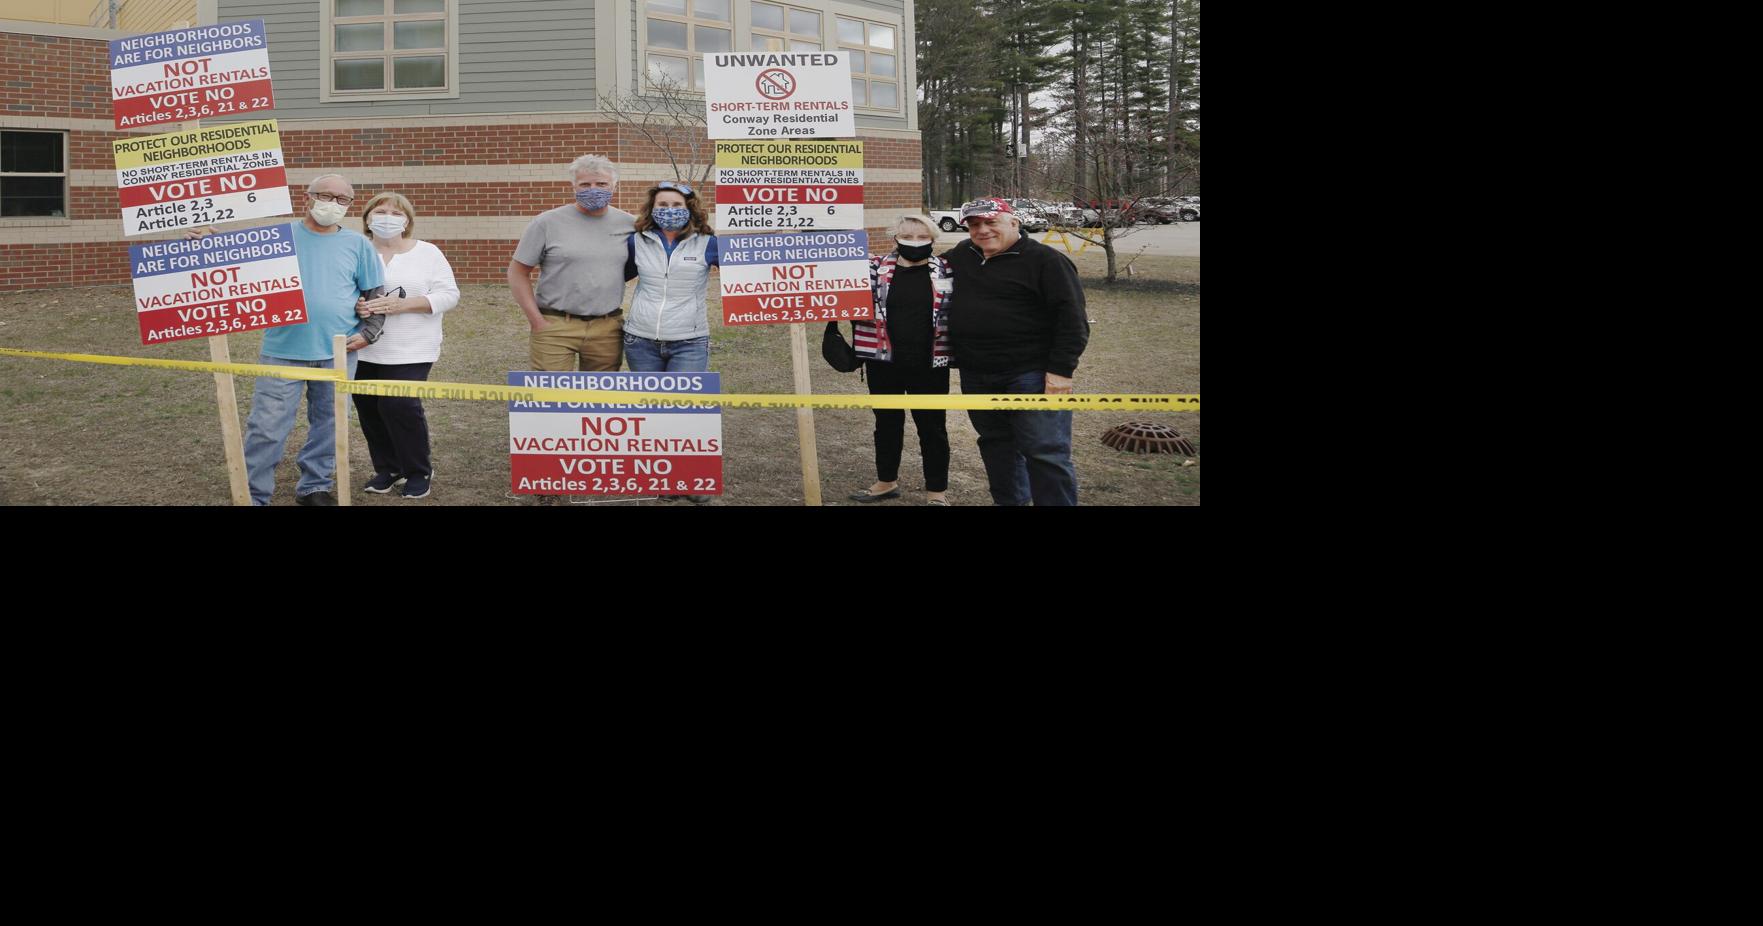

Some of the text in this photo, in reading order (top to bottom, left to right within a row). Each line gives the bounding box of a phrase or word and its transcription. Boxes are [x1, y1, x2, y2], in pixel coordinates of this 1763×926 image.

[121, 23, 251, 51] NEIGHBORHOODS
[114, 36, 261, 65] ARE FOR NEIGHBORS
[164, 58, 211, 78] NOT
[715, 54, 838, 67] UNWANTED
[114, 67, 268, 97] VACATION RENTALS
[150, 87, 234, 109] VOTE NO
[711, 101, 848, 112] SHORT-TERM RENTALS
[120, 110, 172, 126] Articles
[176, 105, 214, 120] 2,3,6,
[218, 101, 234, 112] 21
[252, 97, 269, 107] 22
[723, 114, 838, 125] Conway Residential
[115, 123, 276, 154] PROTECT OUR RESIDENTIAL
[748, 126, 815, 135] Zone Areas
[144, 139, 251, 162] NEIGHBORHOODS
[717, 144, 862, 154] PROTECT OUR RESIDENTIAL
[122, 169, 138, 178] NO
[140, 160, 209, 176] SHORT-TERM
[211, 153, 259, 165] RENTALS
[742, 156, 838, 165] NEIGHBORHOODS
[123, 158, 279, 185] CONWAY RESIDENTIAL ZONES
[149, 173, 256, 201] VOTE NO
[742, 188, 838, 202] VOTE NO
[136, 192, 256, 218] Article 2,3 6
[728, 206, 835, 217] Article 2,3 6
[138, 208, 234, 231] Article 21,22
[728, 218, 814, 228] Article 21,22
[142, 228, 280, 258] NEIGHBORHOODS
[730, 234, 855, 248] NEIGHBORHOODS
[136, 241, 291, 274] ARE FOR NEIGHBORS
[723, 246, 864, 262] ARE FOR NEIGHBORS
[191, 267, 241, 288] NOT
[772, 265, 817, 280] NOT
[139, 276, 300, 309] VACATION RENTALS
[724, 278, 869, 294] VACATION RENTALS
[177, 299, 266, 322] VOTE NO
[758, 295, 838, 309] VOTE NO
[728, 311, 778, 323] Articles
[781, 310, 818, 322] 2,3,6,
[822, 308, 837, 318] 21
[853, 307, 869, 317] 22
[147, 310, 303, 341] Articles 2,3,6, 21 & 22
[524, 375, 703, 391] NEIGHBORHOODS
[581, 417, 646, 436] NOT
[513, 437, 719, 452] VACATION RENTALS
[560, 459, 672, 475] VOTE NO
[518, 477, 716, 492] Articles 2,3,6, 21 & 22
